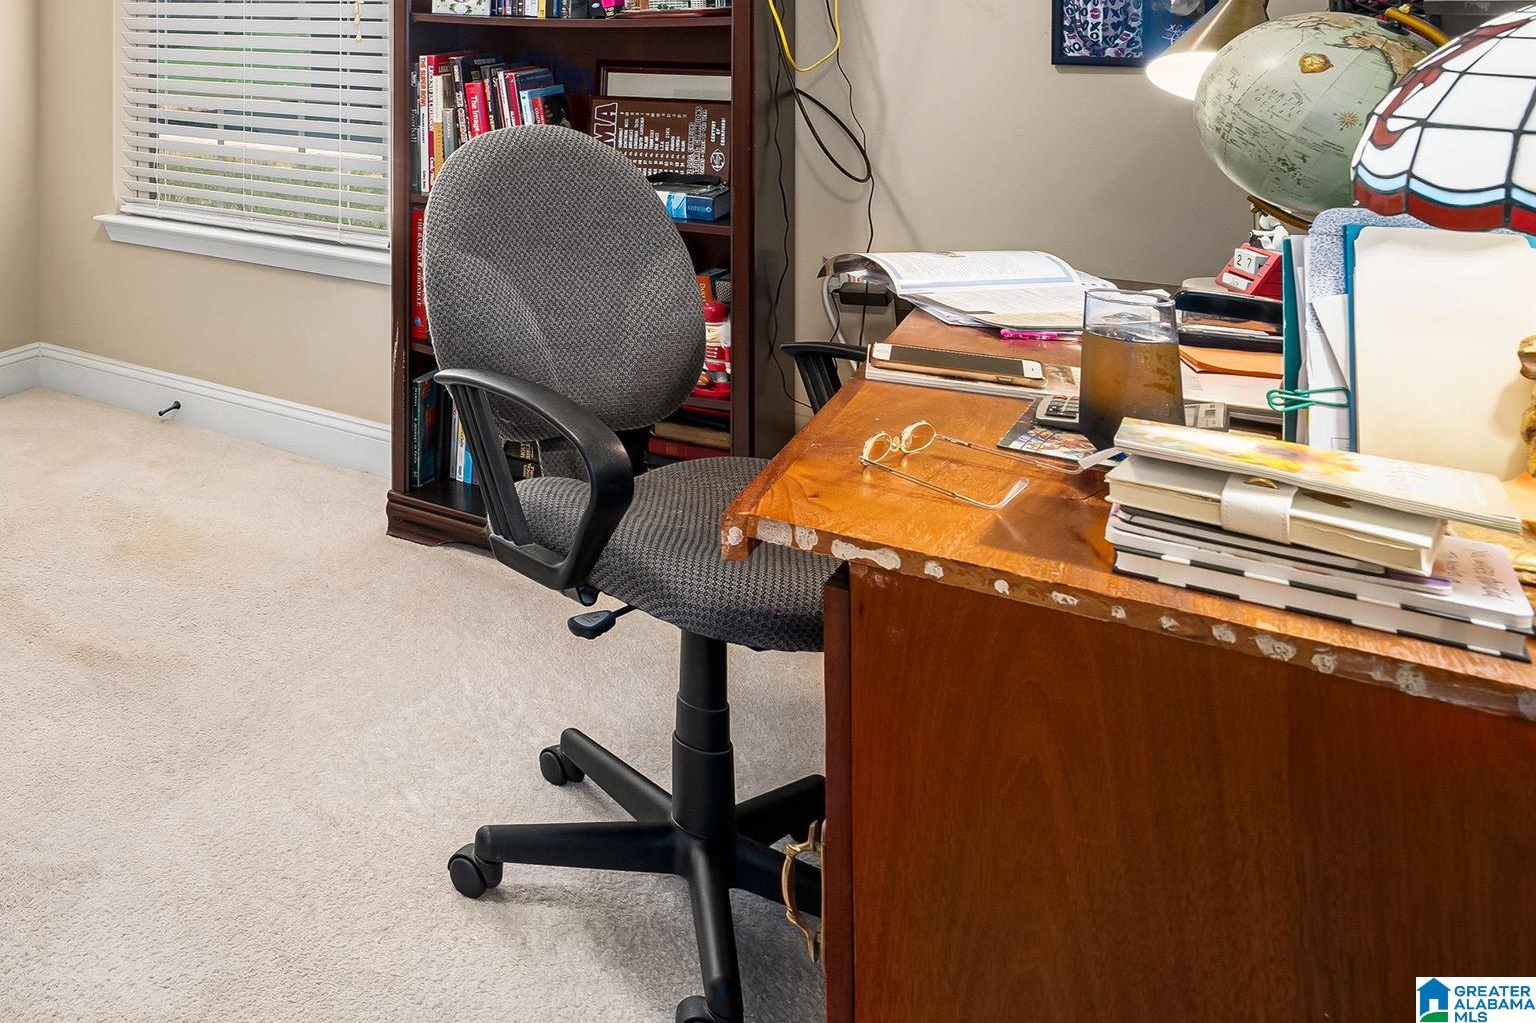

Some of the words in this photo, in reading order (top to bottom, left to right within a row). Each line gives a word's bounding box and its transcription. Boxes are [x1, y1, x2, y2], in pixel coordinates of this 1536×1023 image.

[1254, 88, 1301, 114] PACIFIC
[1264, 85, 1303, 106] NORTH
[1255, 97, 1292, 118] OCEAN
